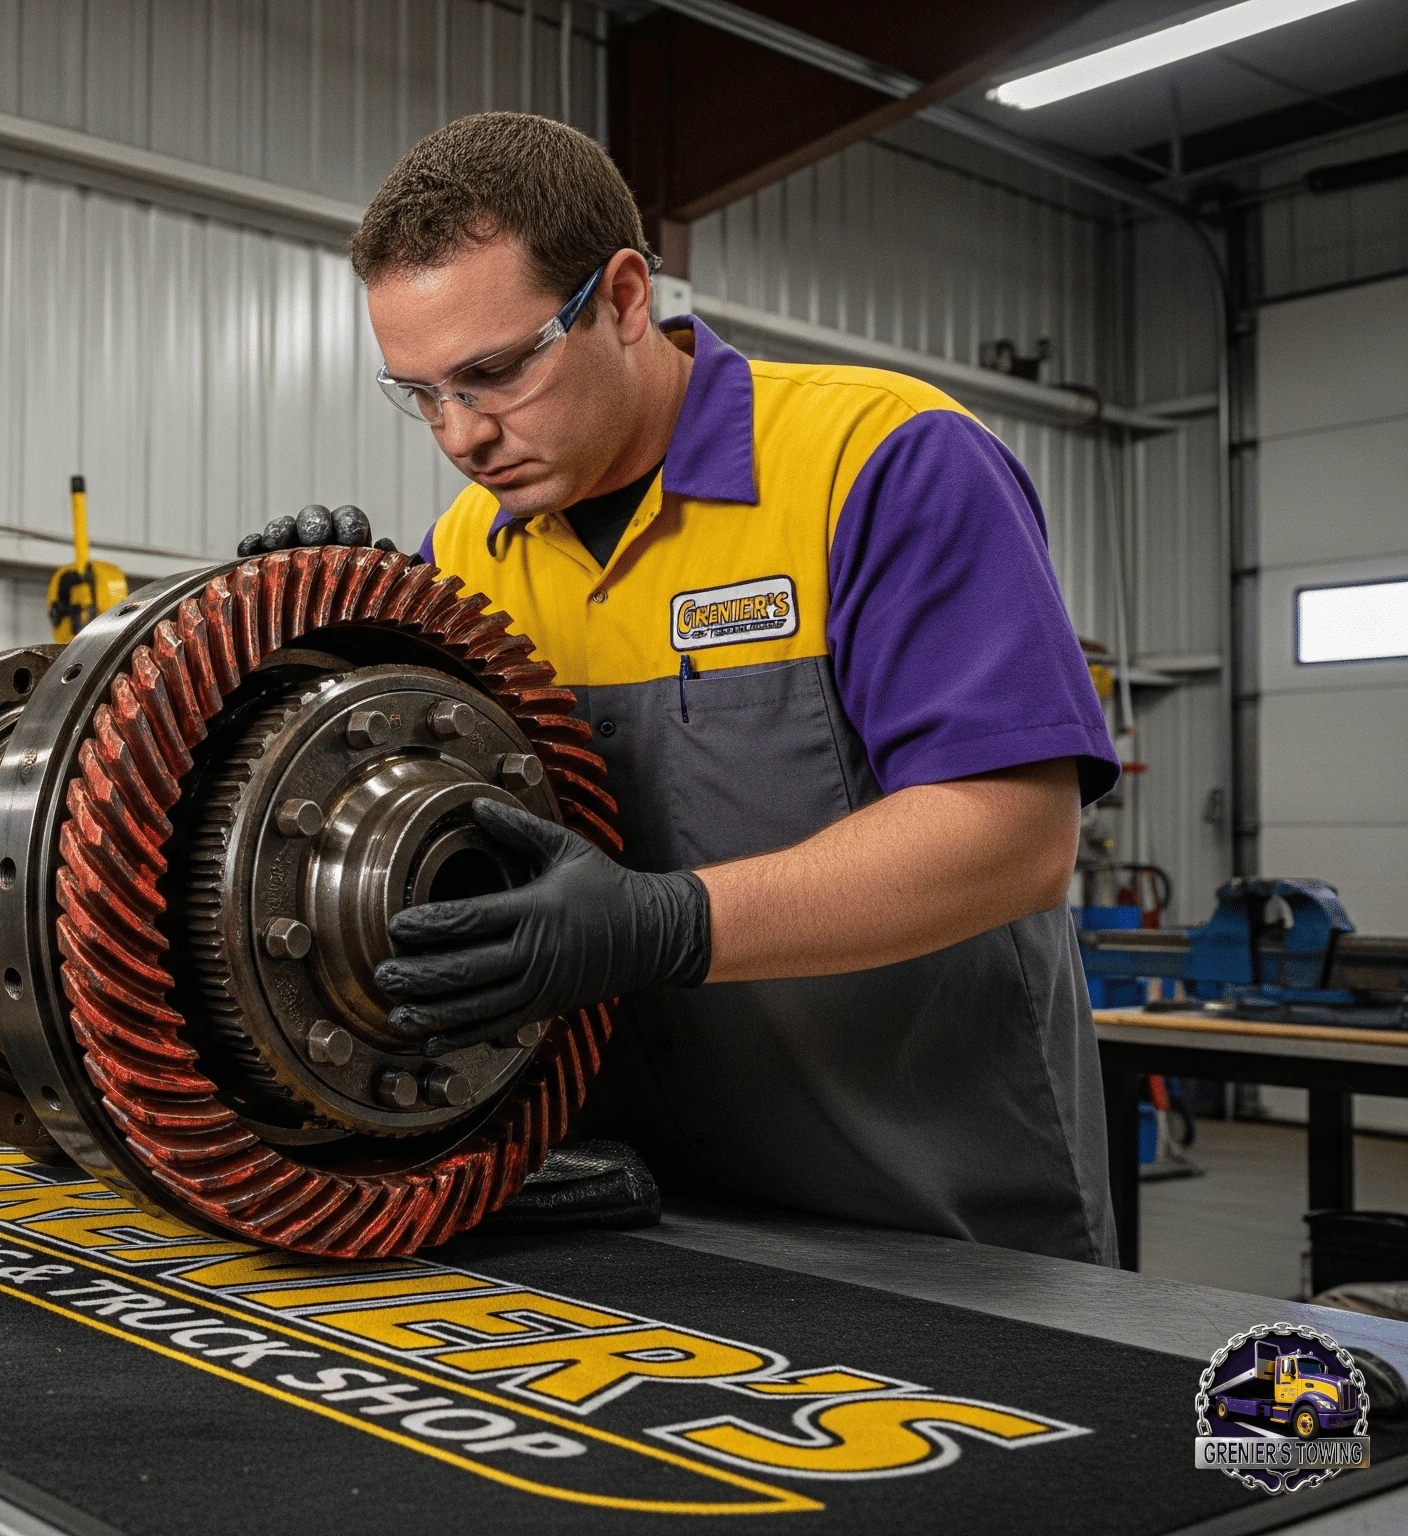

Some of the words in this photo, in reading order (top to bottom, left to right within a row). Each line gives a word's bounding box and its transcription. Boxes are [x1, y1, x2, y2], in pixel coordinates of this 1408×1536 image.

[677, 591, 790, 638] GRENIER'S
[47, 1279, 321, 1368] TRUCK
[277, 1367, 588, 1458] SHOP
